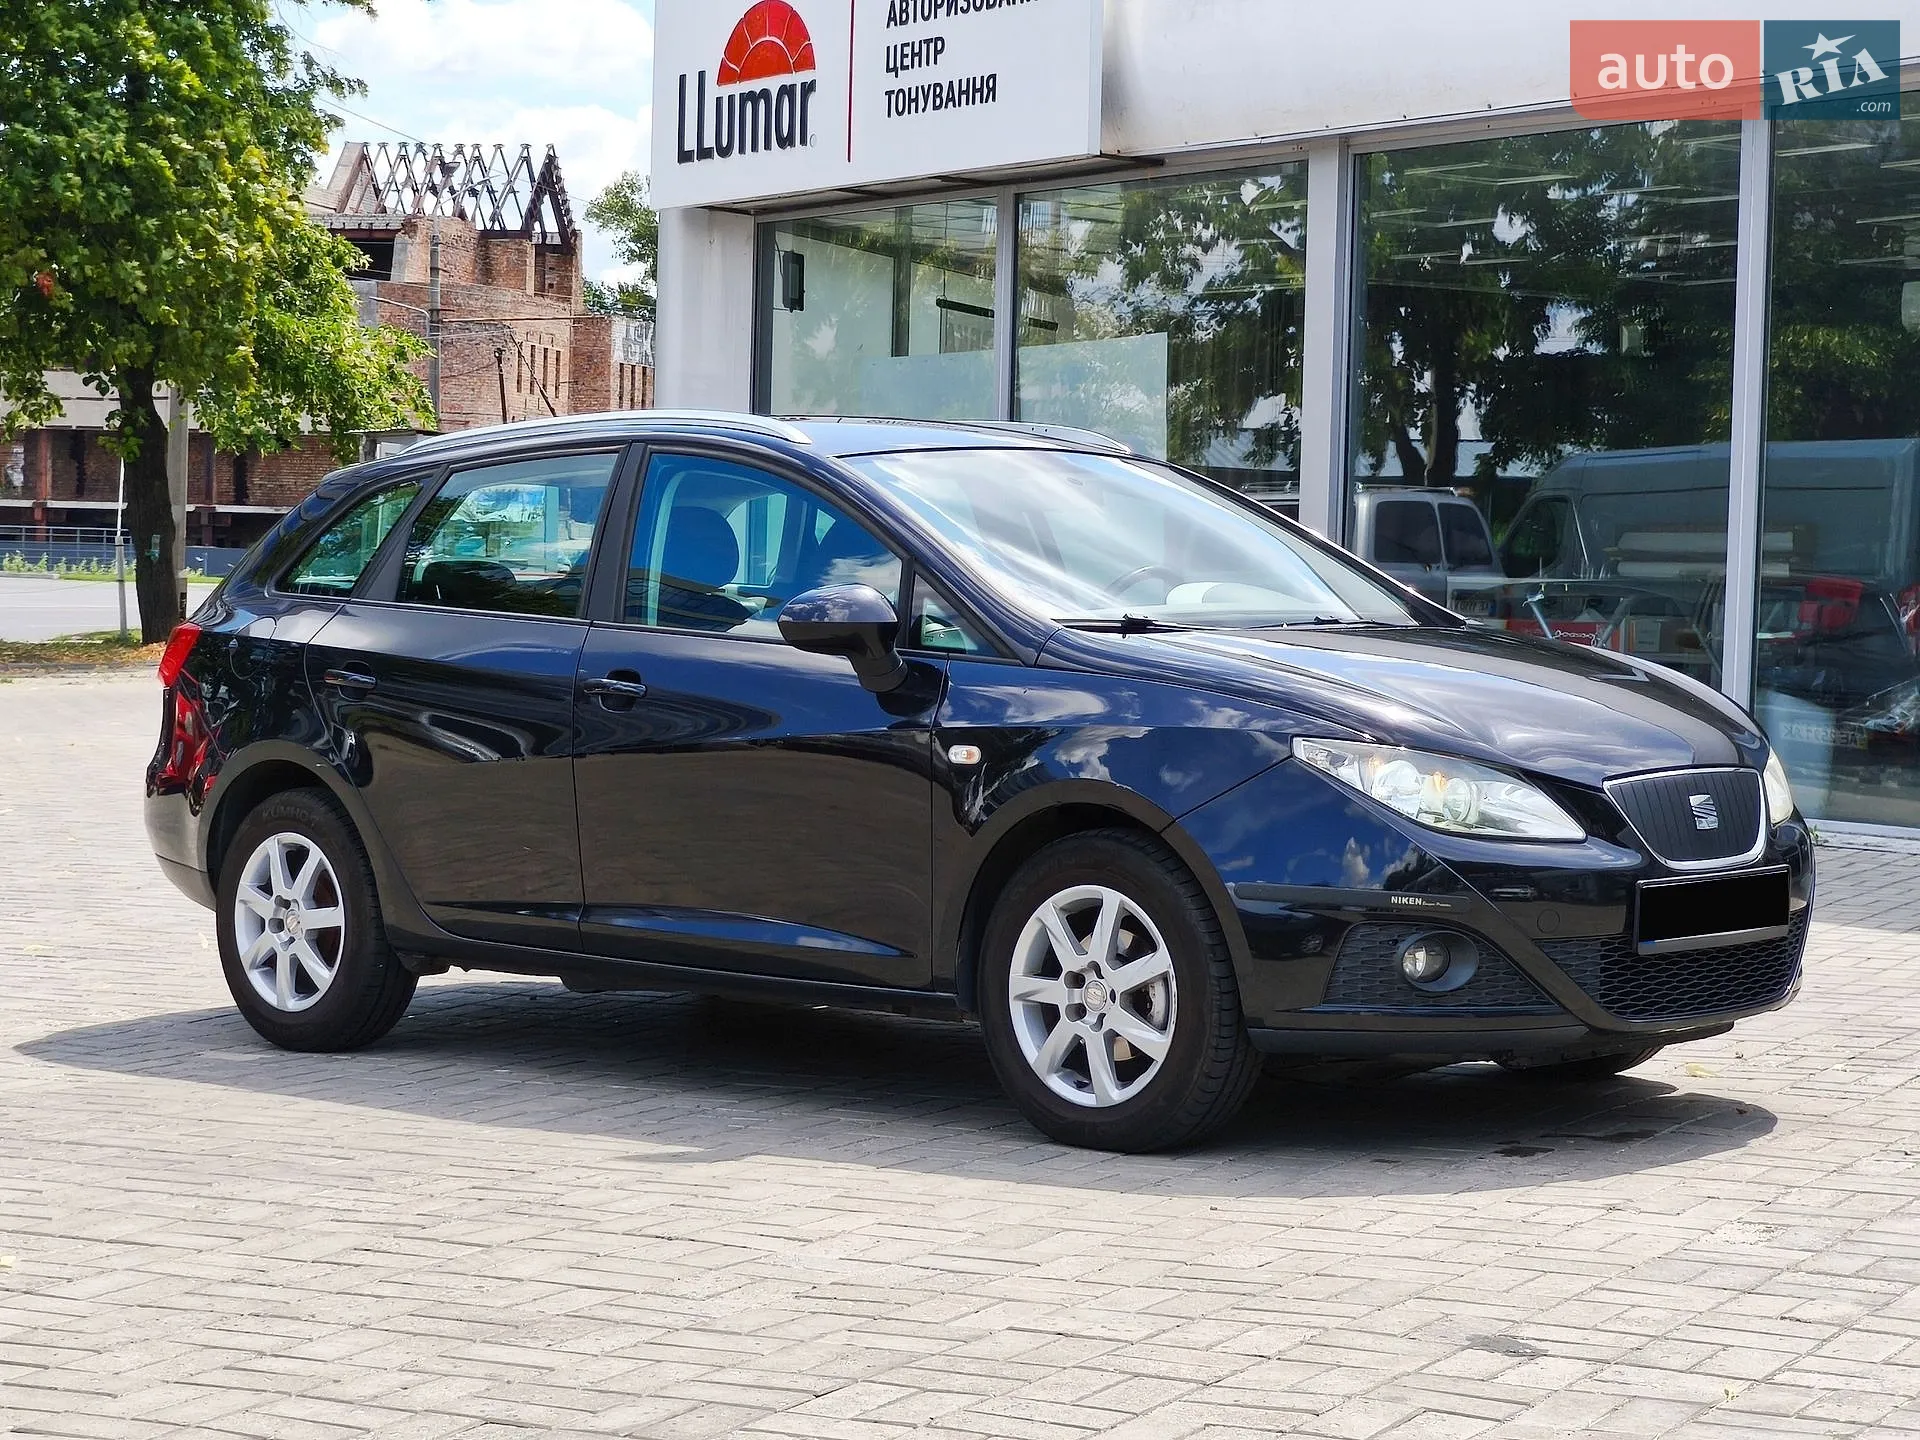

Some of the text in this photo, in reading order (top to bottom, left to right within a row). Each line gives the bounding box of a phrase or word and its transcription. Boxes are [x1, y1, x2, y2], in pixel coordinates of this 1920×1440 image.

[886, 0, 1038, 28] АВТОРИЗ
[885, 36, 945, 78] ЦЕНТР
[677, 70, 817, 164] LLumar
[885, 74, 997, 118] ТОНУВАННЯ
[1391, 896, 1422, 905] NIKEN
